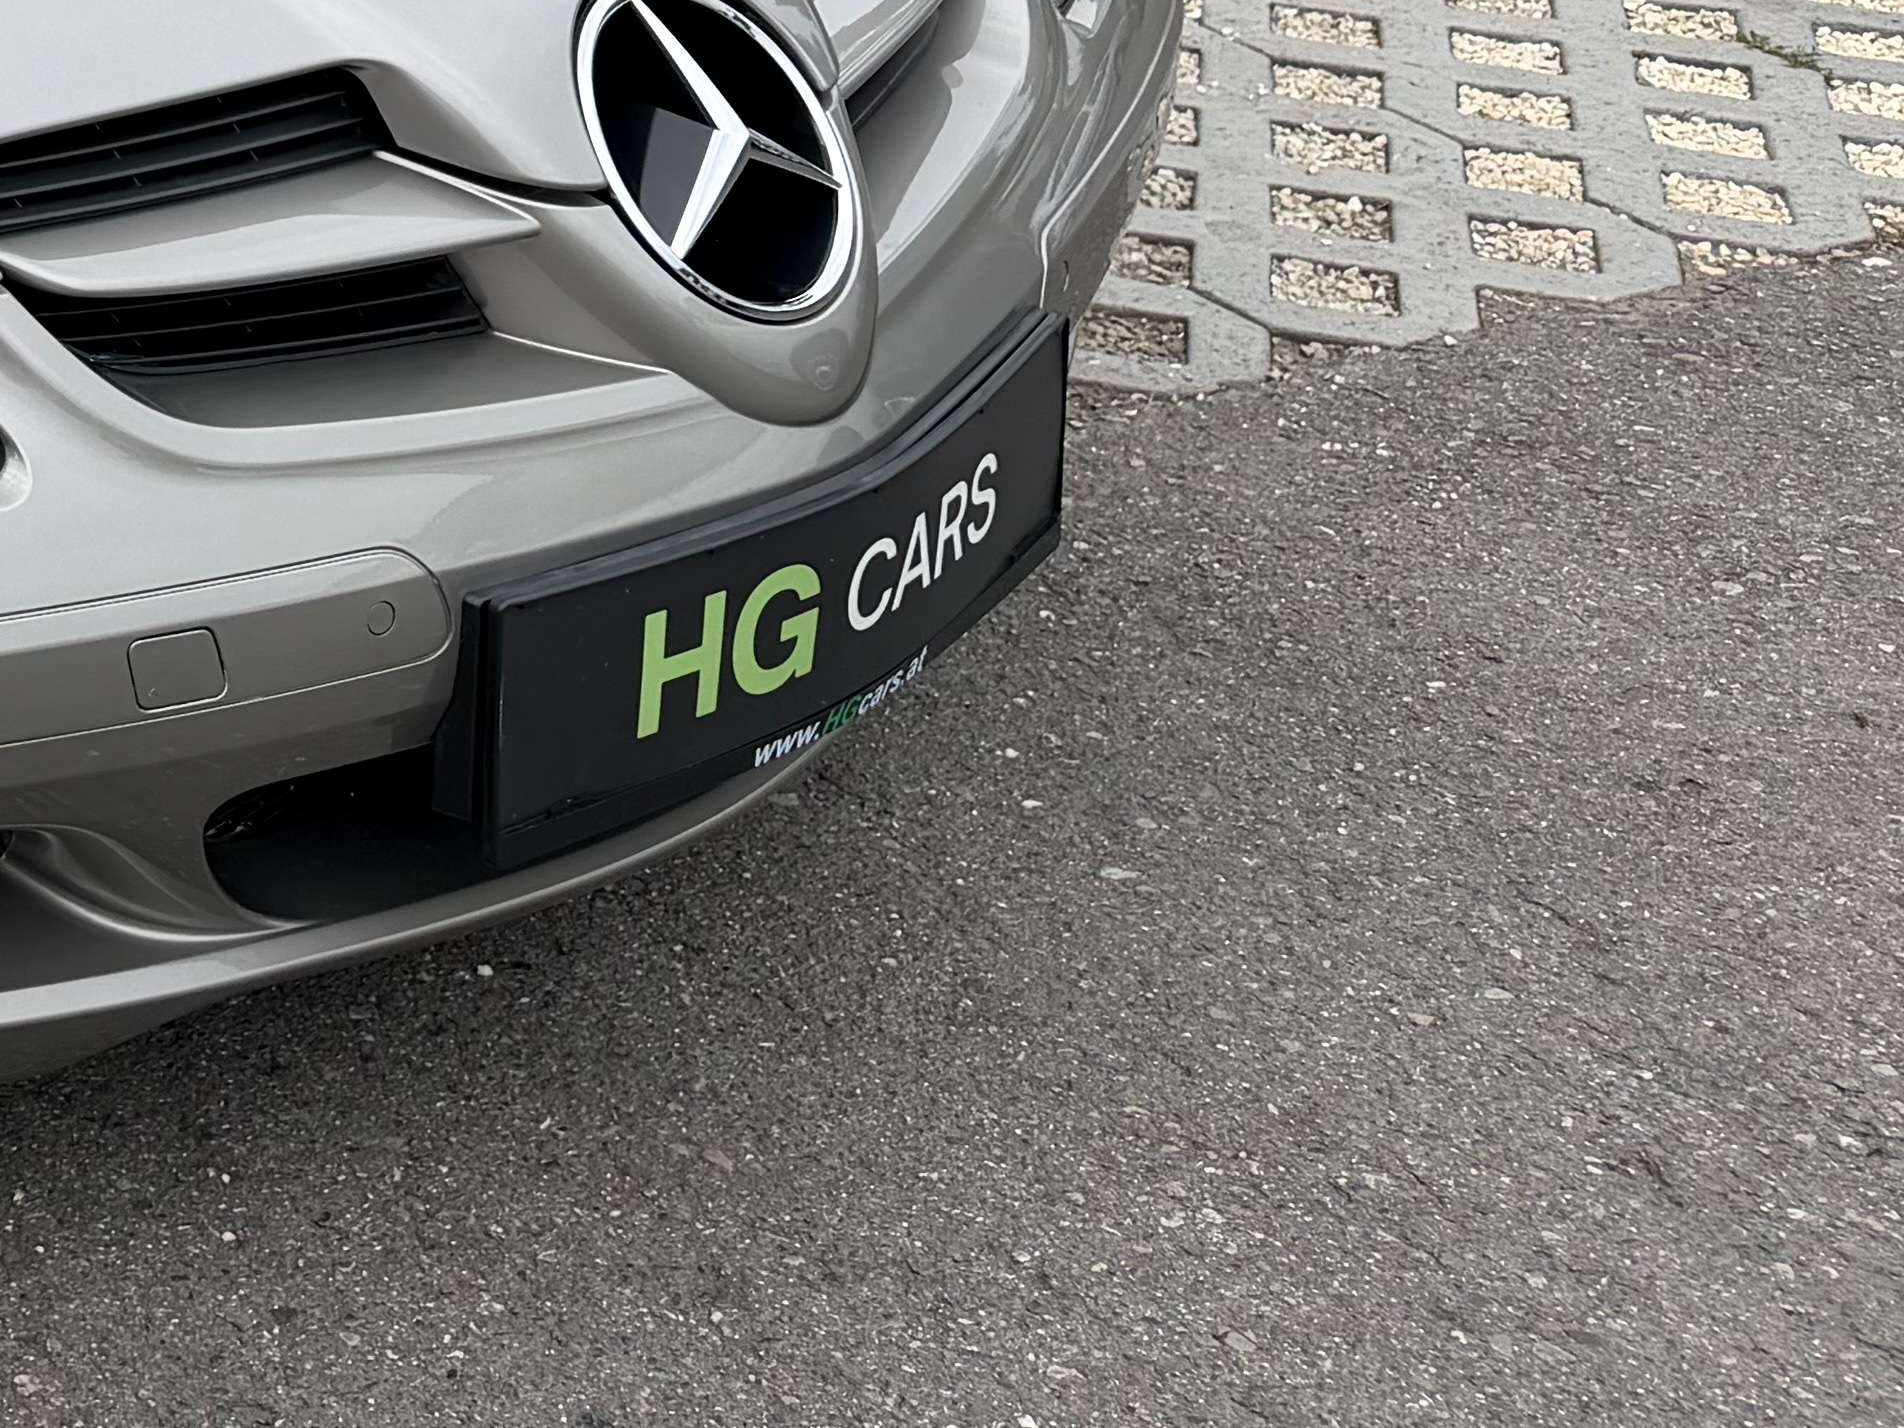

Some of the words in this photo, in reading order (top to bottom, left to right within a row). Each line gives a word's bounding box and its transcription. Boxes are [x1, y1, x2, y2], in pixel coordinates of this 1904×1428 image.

[846, 452, 999, 632] CARS
[636, 562, 822, 739] HG
[753, 644, 929, 768] www.HGcars.at
